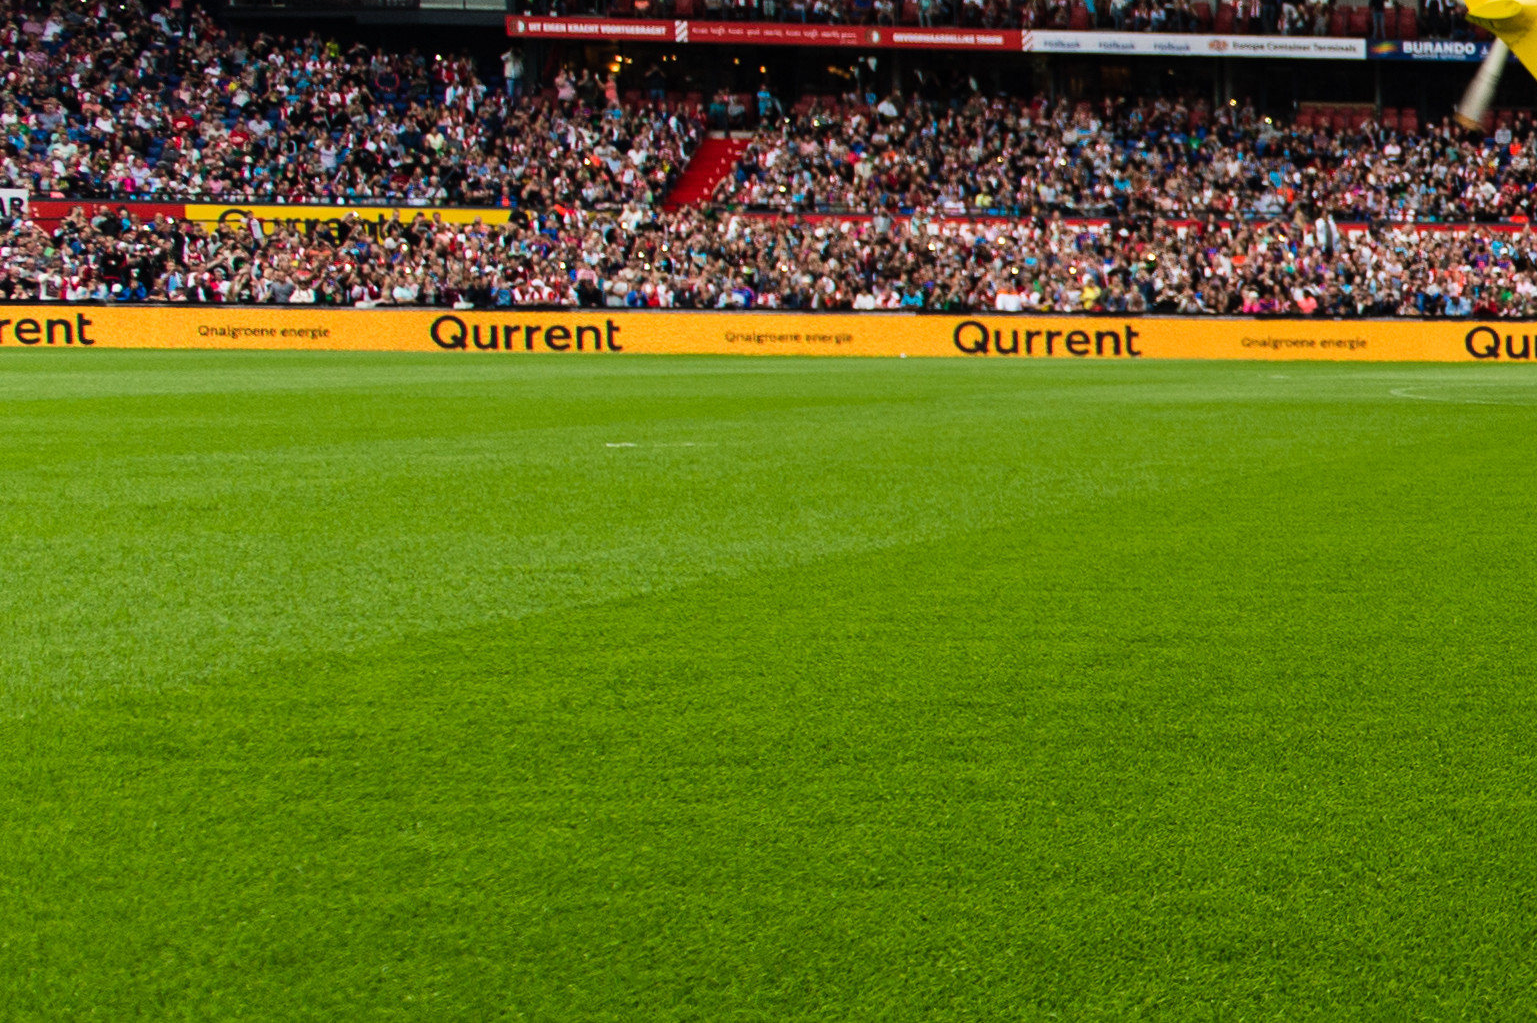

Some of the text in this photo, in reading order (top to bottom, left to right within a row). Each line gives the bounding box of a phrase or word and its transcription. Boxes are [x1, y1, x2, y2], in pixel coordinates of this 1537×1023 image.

[1402, 41, 1476, 55] BURANDO
[0, 313, 96, 346] rent
[280, 325, 330, 341] energie
[430, 315, 623, 352] Qurrent
[804, 331, 854, 345] energie
[953, 320, 1142, 357] Qurrent
[1319, 336, 1368, 351] energie
